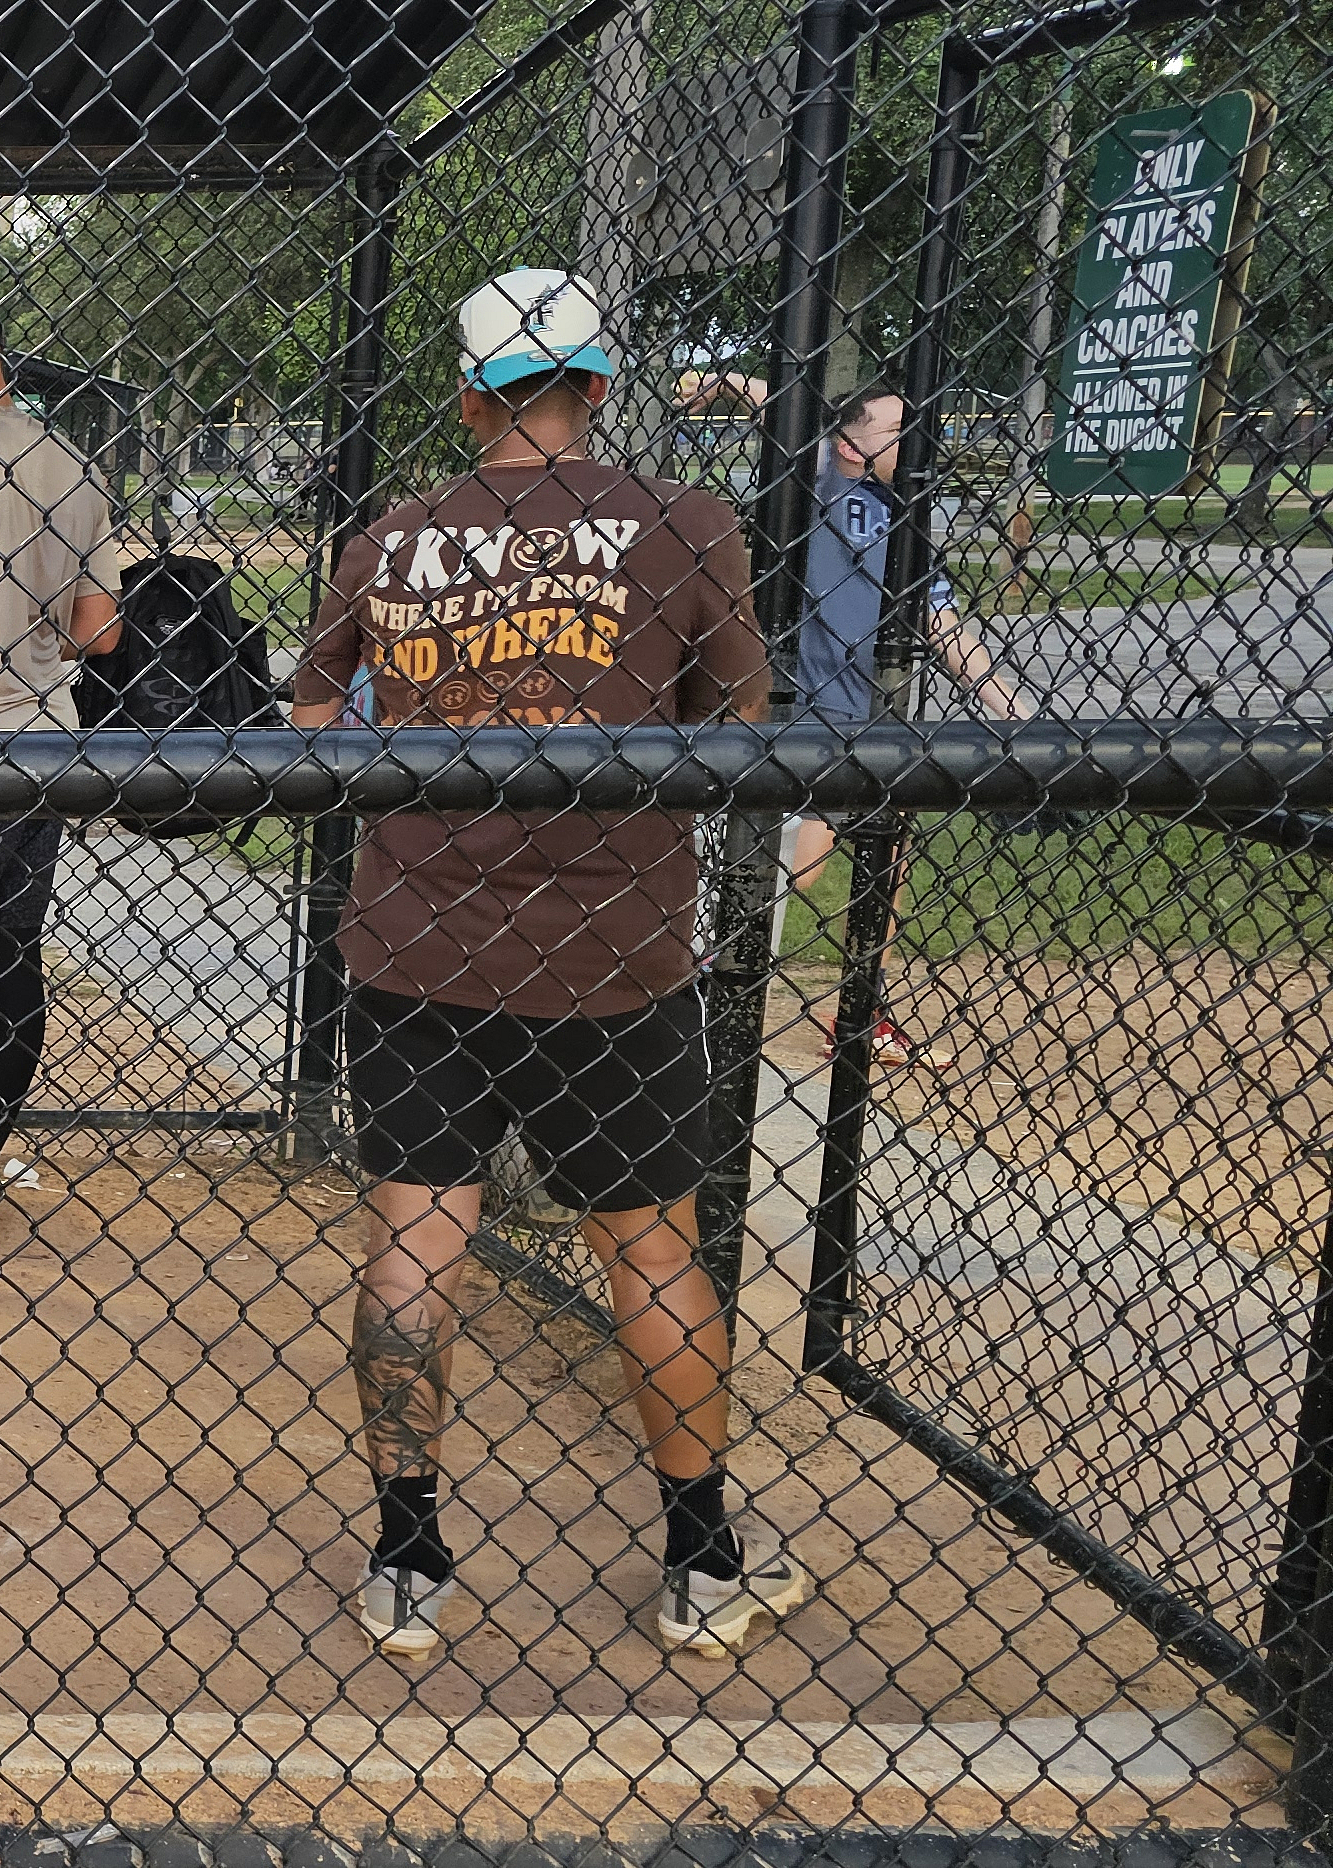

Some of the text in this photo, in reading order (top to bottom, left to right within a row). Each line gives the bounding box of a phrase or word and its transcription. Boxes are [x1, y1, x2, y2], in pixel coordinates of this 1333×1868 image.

[1133, 138, 1207, 195] ONLY
[1095, 199, 1217, 261] PLAYERS
[1114, 260, 1173, 310] AND
[1077, 308, 1199, 365] COACHES
[1068, 374, 1188, 416] ALLOWED IN
[1063, 415, 1184, 454] THE DUGOUT
[374, 530, 404, 588] I
[367, 595, 465, 632] WHERE
[526, 573, 629, 615] FROM
[373, 607, 619, 682] AND WHERE
